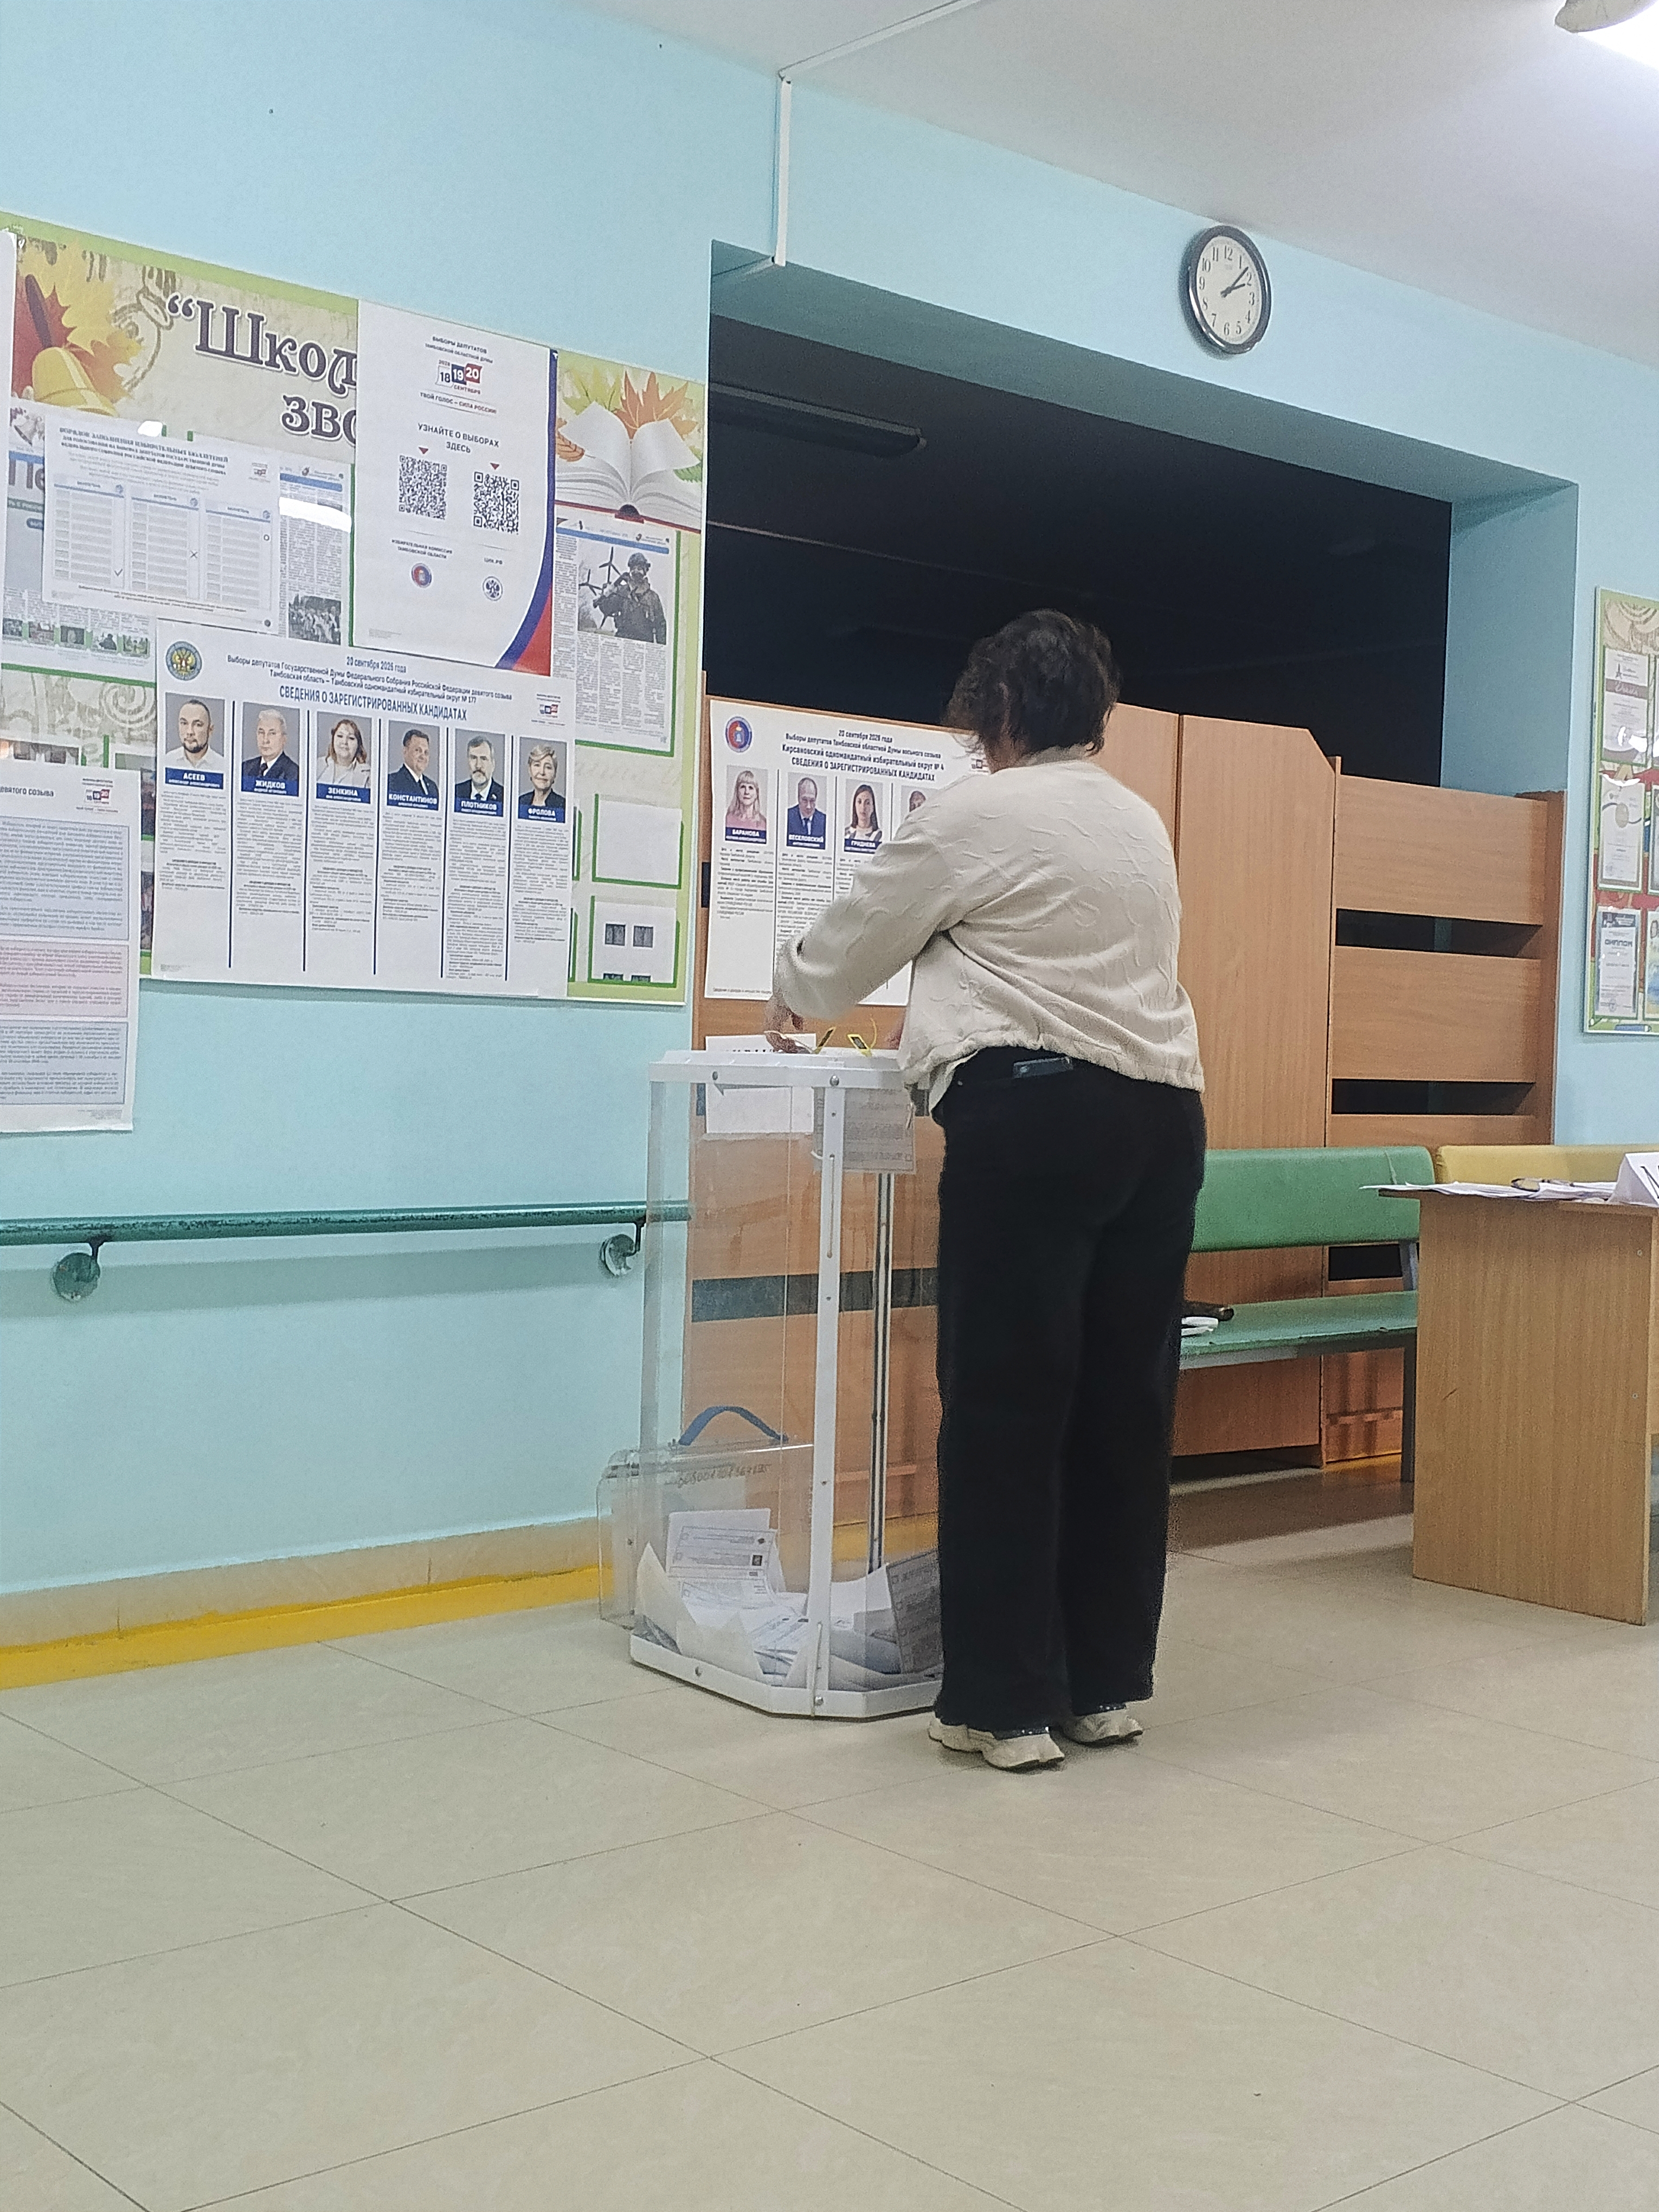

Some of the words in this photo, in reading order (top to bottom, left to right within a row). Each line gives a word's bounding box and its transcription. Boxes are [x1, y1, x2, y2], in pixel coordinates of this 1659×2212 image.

[1213, 247, 1218, 261] 11
[1224, 245, 1232, 261] 12
[1203, 258, 1211, 272] 10
[1199, 276, 1205, 290] 9
[1247, 272, 1252, 286] 2
[1203, 298, 1208, 310] 8
[1249, 292, 1255, 305] 3
[1212, 313, 1217, 327] 7
[1245, 310, 1250, 324] 4
[1224, 322, 1230, 336] 6
[1236, 321, 1241, 334] 5
[440, 372, 450, 383] 18
[453, 369, 463, 381] 19
[466, 367, 479, 379] 20
[454, 384, 480, 394] СЕНТЯБРЯ
[435, 396, 453, 404] ГОЛОС
[474, 404, 497, 414] РОССИИ
[418, 423, 453, 437] УЗНАЙТЕ
[463, 433, 499, 447] ВЫБОРАХ
[446, 442, 471, 453] ЗДЕСЬ
[355, 658, 380, 671] сентября
[395, 665, 406, 673] года
[228, 655, 250, 665] Выборы
[252, 659, 280, 668] депутатов
[281, 662, 329, 675] Государственной
[330, 669, 344, 678] Думы
[346, 671, 385, 683] Федерального
[386, 677, 411, 687] Собрания
[412, 680, 441, 691] Российской
[442, 685, 470, 696] Федерации
[271, 670, 302, 680] Тамбовская
[303, 674, 324, 684] область
[332, 678, 363, 689] Тамбовский
[364, 683, 406, 694] одномандатный
[408, 688, 445, 699] избирательный
[280, 685, 320, 702] СВЕДЕНИЯ
[322, 692, 327, 703] О
[329, 692, 418, 715] ЗАРЕГИСТРИРОВАННЫХ
[419, 702, 466, 721] КАНДИДАТАХ
[786, 733, 806, 742] Выборы
[782, 744, 824, 756] Кирсановский
[825, 751, 872, 762] одномандатный
[873, 756, 916, 767] избирательный
[792, 757, 823, 768] СВЕДЕНИЯ
[830, 762, 897, 776] ЗАРЕГИСТРИРОВАННЫХ
[899, 770, 935, 781] КАНДИДАТАХ
[183, 773, 205, 781] АСЕЕВ
[256, 780, 285, 789] ЖИДКОВ
[328, 787, 357, 796] ЗЕНКИНА
[28, 789, 54, 797] созыва
[389, 794, 437, 804] КОНСТАНТИНОВ
[461, 801, 497, 810] ПЛОТНИКОВ
